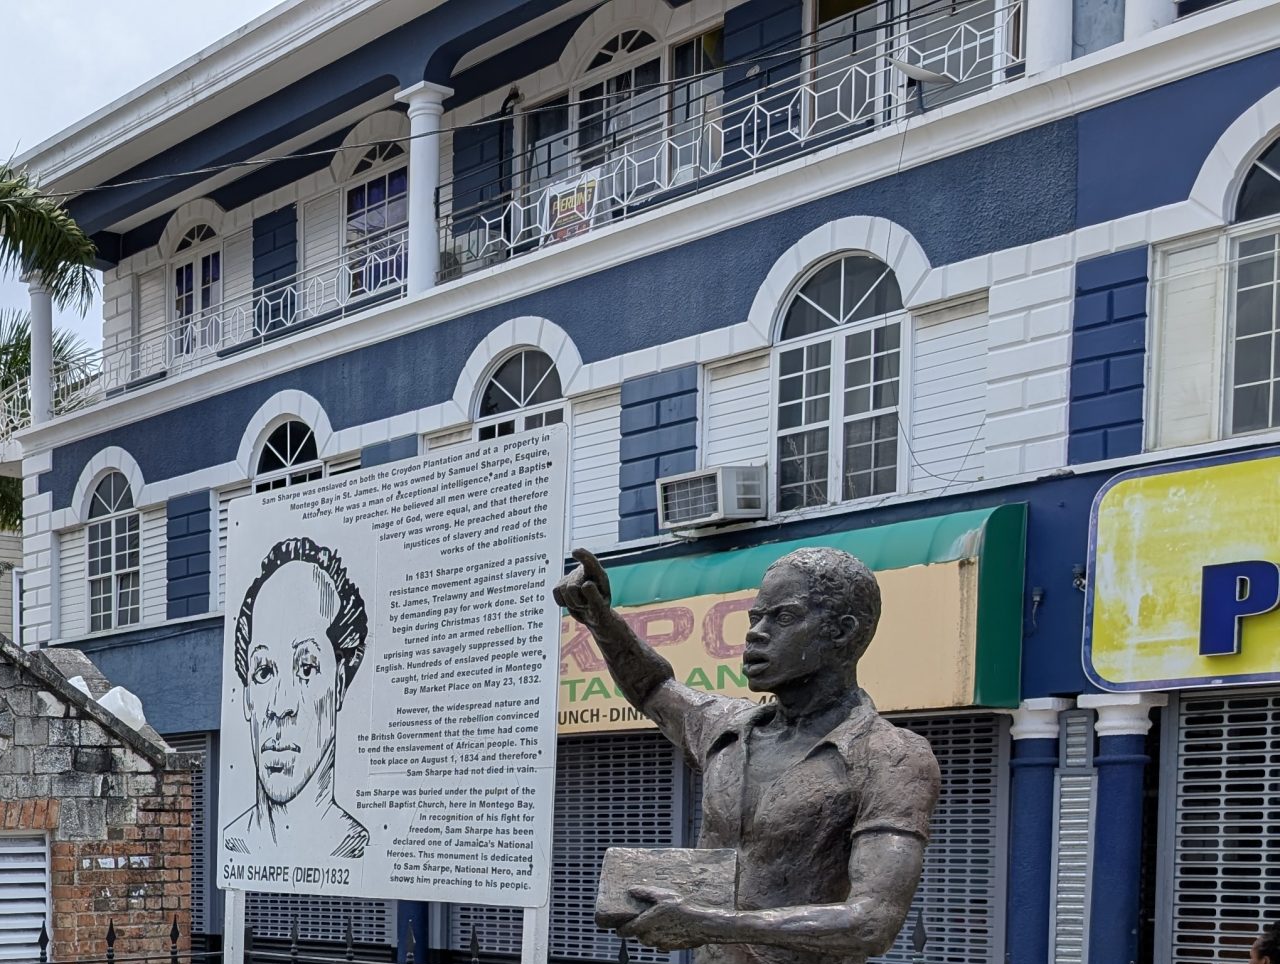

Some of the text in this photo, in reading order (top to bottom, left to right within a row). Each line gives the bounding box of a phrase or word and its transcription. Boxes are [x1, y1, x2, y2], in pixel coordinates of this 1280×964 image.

[371, 520, 394, 530] image
[405, 513, 423, 524] God,
[424, 510, 444, 520] were
[446, 503, 470, 516] equal,
[472, 500, 488, 511] and
[490, 496, 507, 507] that
[509, 490, 548, 504] therefore
[379, 530, 406, 542] slavery
[407, 527, 423, 536] was
[424, 522, 451, 533] wrong.
[467, 510, 505, 527] preached
[507, 505, 531, 517] about
[533, 503, 548, 512] the
[440, 545, 464, 555] works
[476, 540, 491, 549] the
[492, 531, 546, 547] abolitionists.
[405, 573, 413, 582] In
[415, 569, 433, 580] 1831
[435, 566, 463, 577] Sharpe
[465, 558, 505, 573] organized
[514, 553, 546, 566] passive
[389, 565, 546, 596] resistance movement against slavery in
[390, 578, 545, 609] St. James, Trelawny and Westmoreland
[389, 593, 545, 622] by demanding pay for work done. Set to
[392, 607, 544, 634] begin during Christmas 1831 the strike
[404, 620, 543, 644] turned into an armed rebellion. The
[383, 634, 543, 661] uprising was savagely suppressed by the
[375, 649, 542, 674] English. Hundreds of enslaved people were
[391, 662, 542, 684] caught, tried and executed in Montego
[403, 686, 418, 696] Bay
[419, 683, 446, 693] Market
[447, 682, 470, 691] Place
[483, 679, 501, 689] May
[502, 677, 515, 686] 23,
[518, 675, 541, 684] 1832.
[396, 696, 540, 715] However, the widespread nature and
[388, 710, 539, 728] seriousness of the rebellion convinced
[355, 789, 371, 797] Sam
[373, 788, 400, 798] Sharpe
[418, 787, 443, 796] buried
[444, 787, 467, 795] under
[469, 787, 483, 795] the
[484, 786, 508, 797] pulpit
[510, 786, 520, 795] of
[521, 786, 536, 795] the
[356, 799, 534, 810] Burchell Baptist Church, here in Montego Bay.
[419, 812, 535, 824] In recognition of his fight for
[408, 825, 534, 837] freedom, Sam Sharpe has been
[223, 864, 245, 880] SAM
[247, 865, 289, 882] SHARPE
